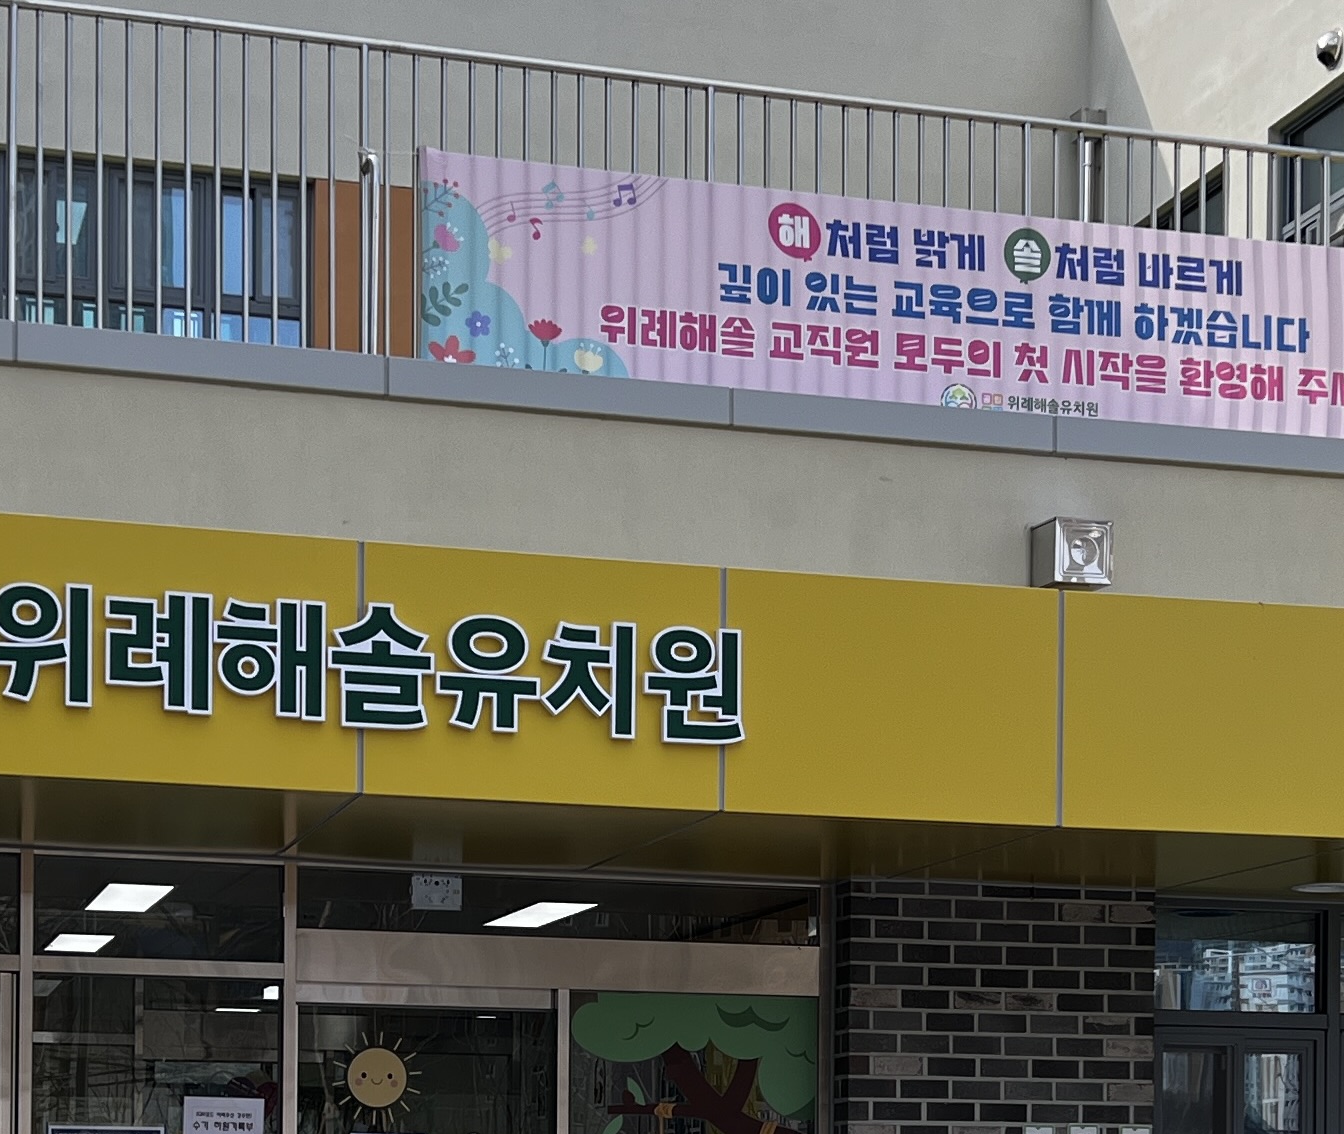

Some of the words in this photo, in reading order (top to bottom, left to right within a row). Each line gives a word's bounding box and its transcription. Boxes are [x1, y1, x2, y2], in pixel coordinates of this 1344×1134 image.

[777, 214, 899, 265] 해처럼
[913, 228, 985, 272] 밝게
[1012, 239, 1125, 287] 솔처럼
[1137, 250, 1243, 297] 바르게
[717, 262, 791, 307] 깊이
[804, 271, 878, 315] 있는
[891, 281, 1036, 330] 교육으로
[1048, 292, 1122, 338] 함께
[1133, 303, 1311, 353] 하겠습니다
[600, 304, 757, 358] 위례해솔
[769, 320, 879, 369] 교직원
[893, 332, 1002, 379] 모두의
[1014, 342, 1049, 384] 첫
[1061, 348, 1167, 395] 시작을
[1178, 356, 1285, 403] 환영해
[1007, 395, 1099, 418] 위례해솔유치원
